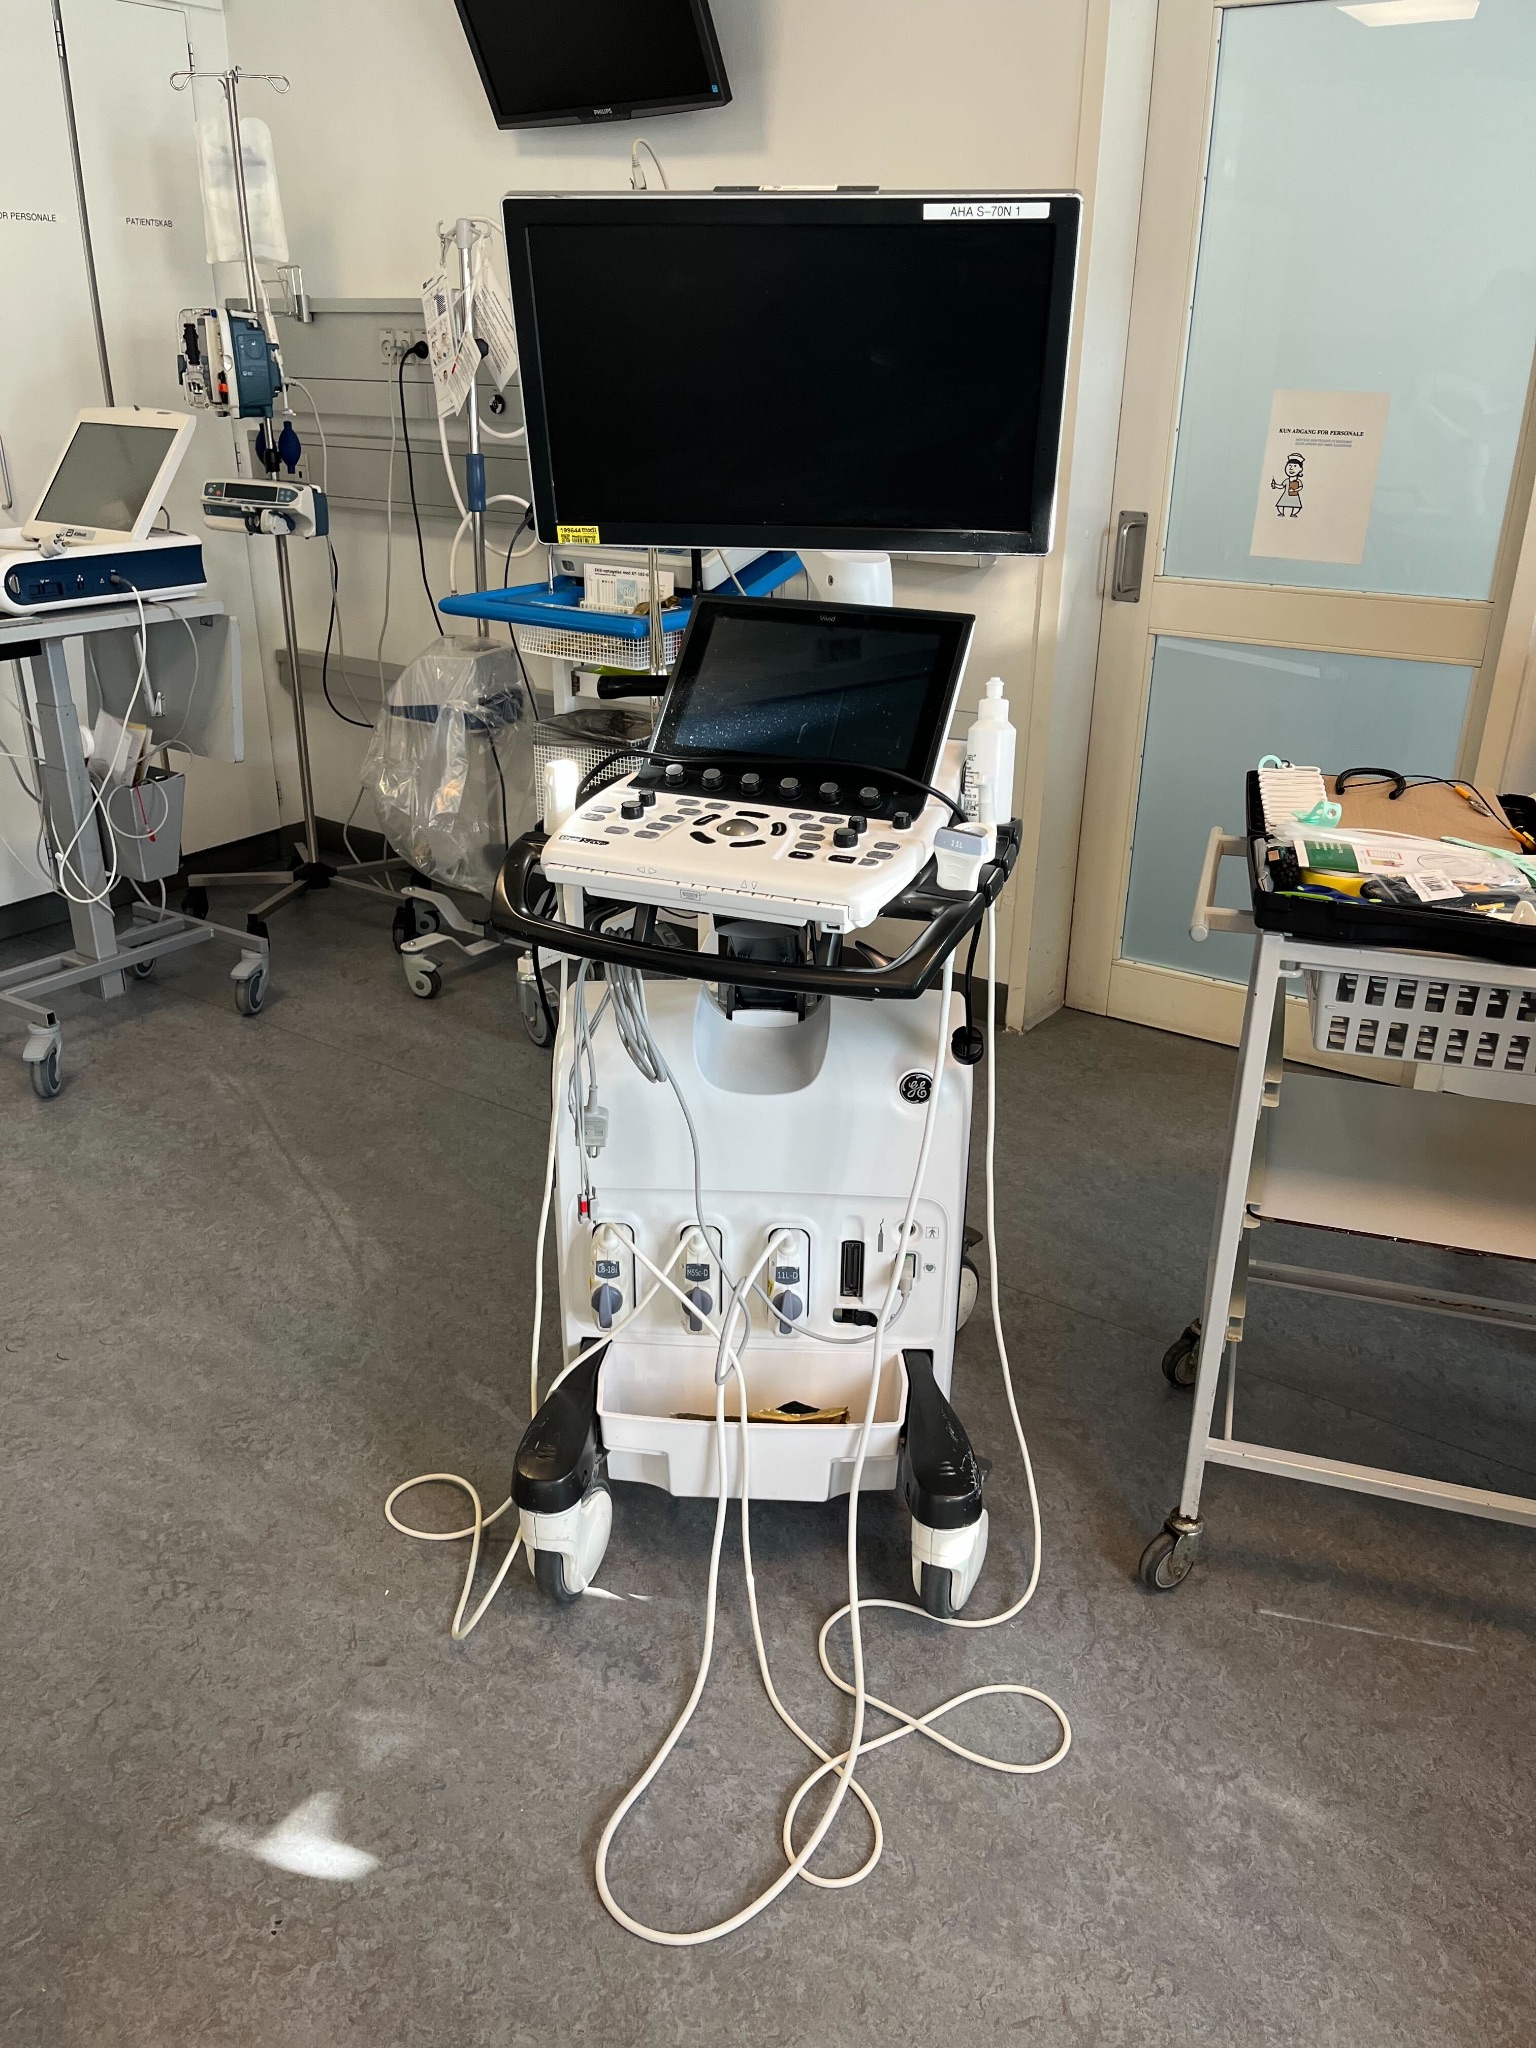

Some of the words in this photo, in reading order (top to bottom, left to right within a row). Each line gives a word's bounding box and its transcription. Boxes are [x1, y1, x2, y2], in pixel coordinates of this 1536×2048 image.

[593, 107, 613, 116] PHILIPS
[950, 206, 974, 217] AHA
[976, 205, 1012, 217] S-70N
[1015, 205, 1021, 217] 1
[10, 212, 57, 223] PERSONALE
[125, 217, 173, 228] PATIENTSKAB
[950, 839, 964, 849] 11L
[777, 1271, 799, 1280] 11L-D
